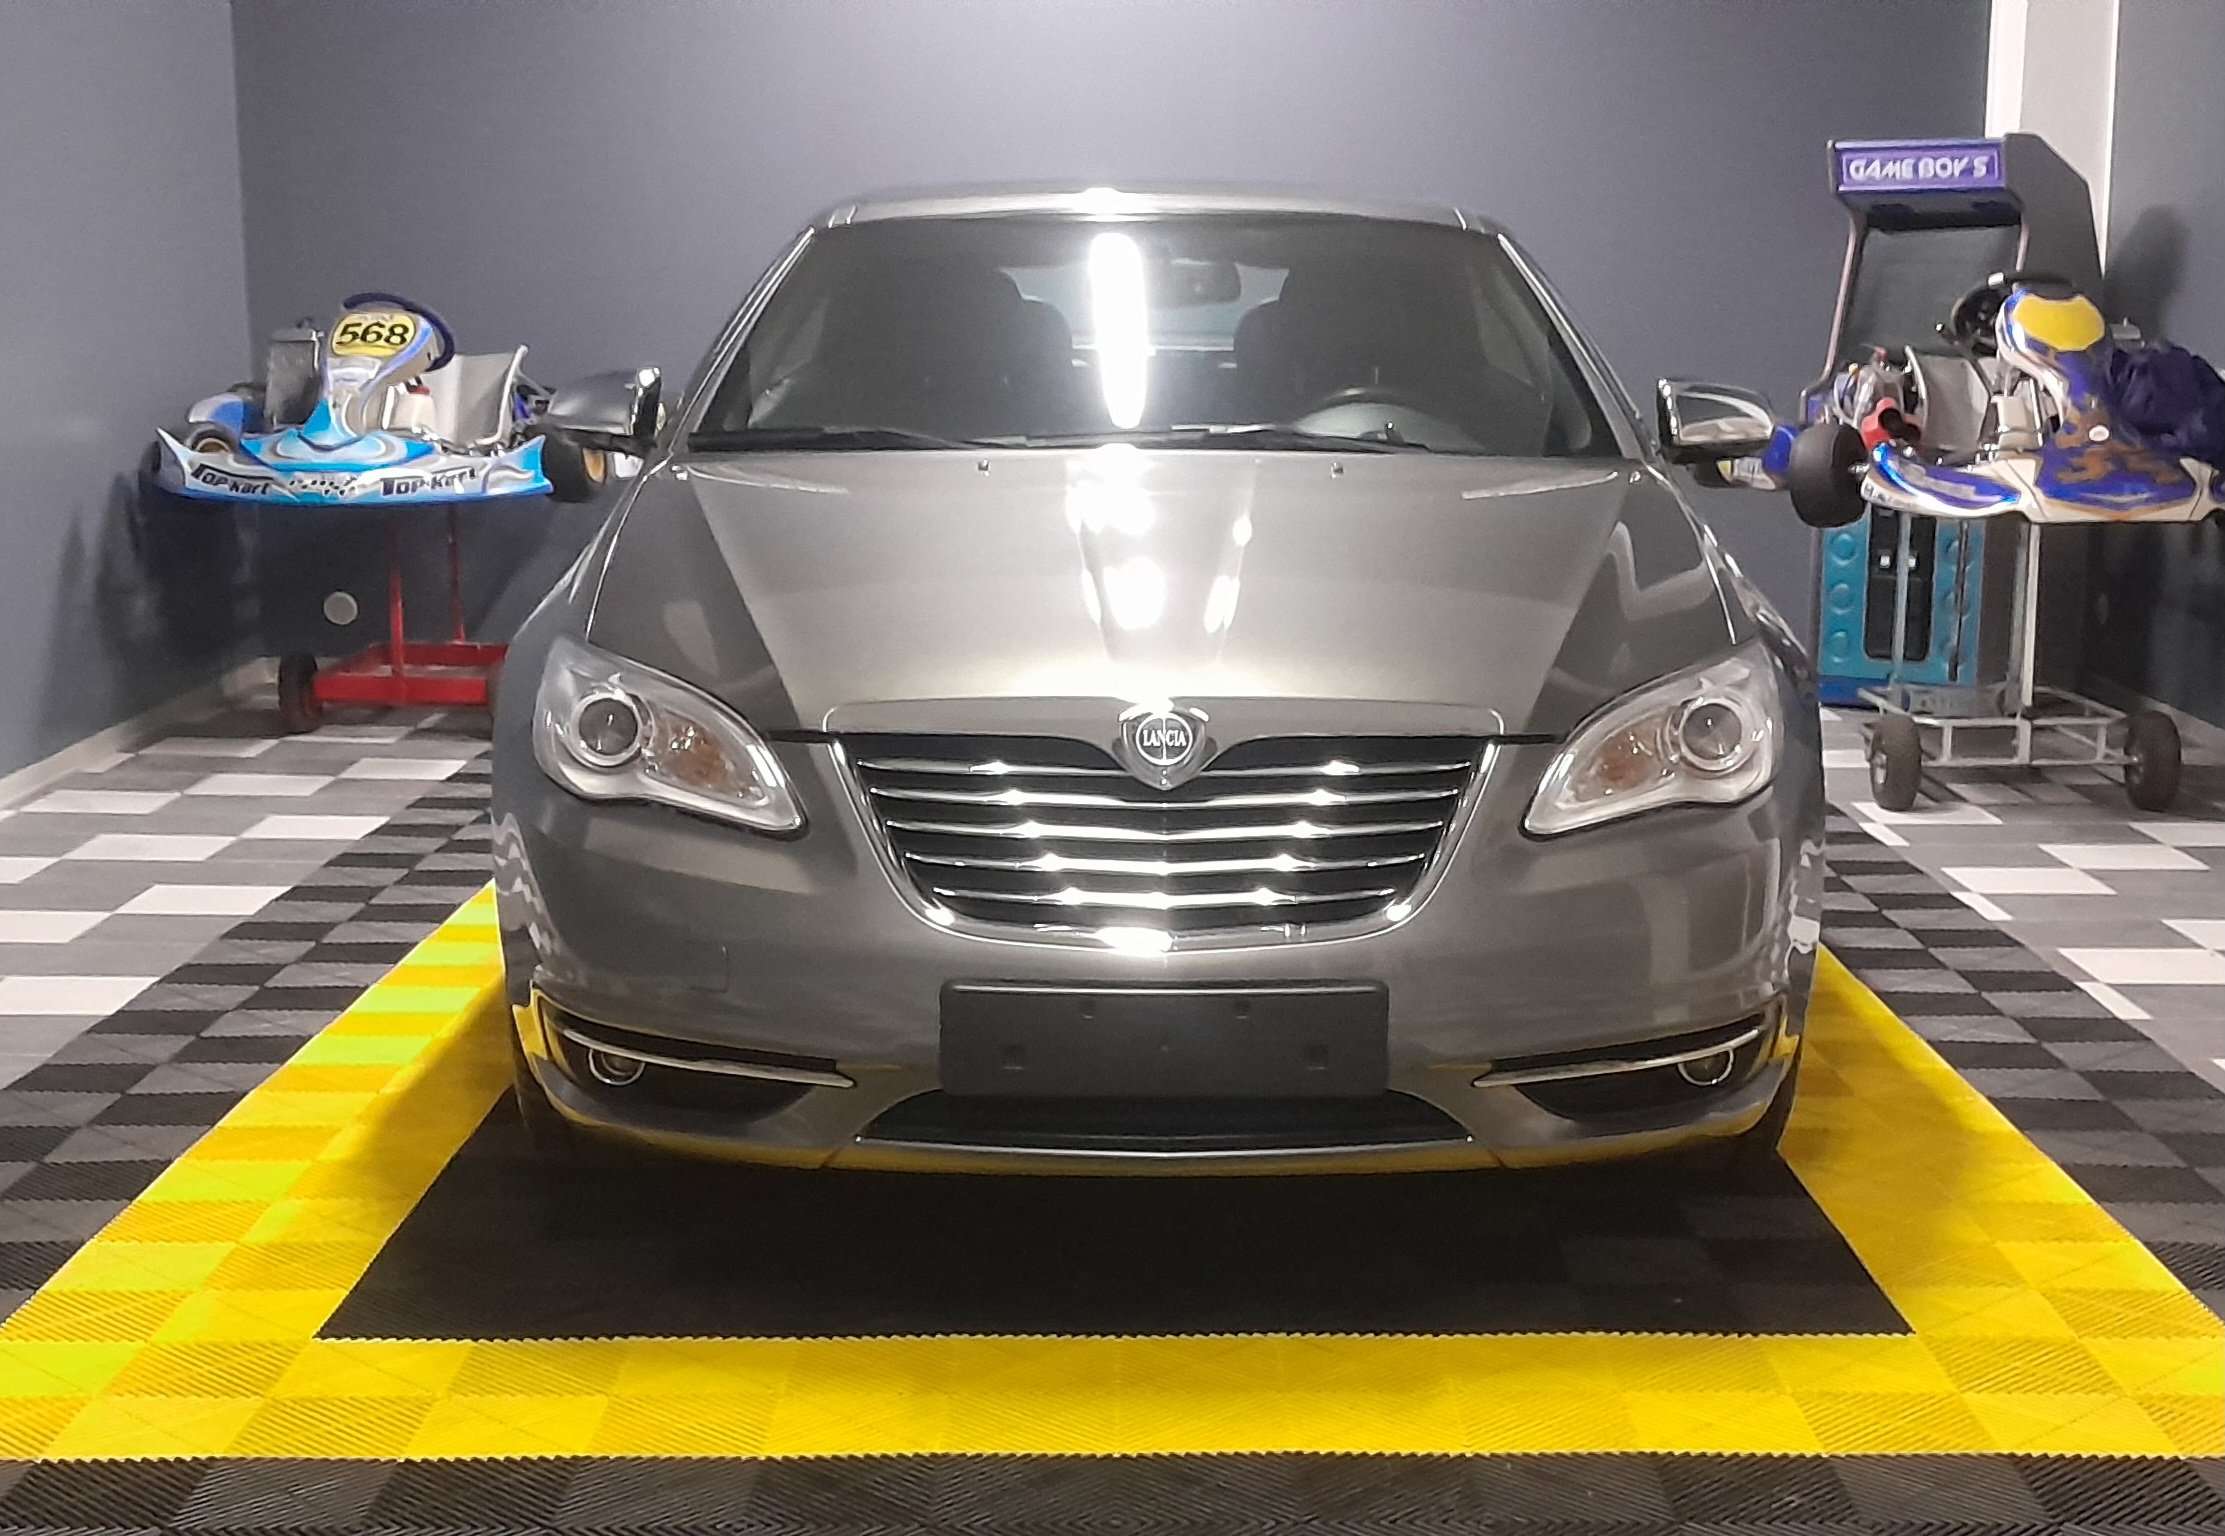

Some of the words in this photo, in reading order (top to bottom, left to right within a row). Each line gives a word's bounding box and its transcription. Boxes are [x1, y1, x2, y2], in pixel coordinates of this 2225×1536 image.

[1849, 157, 1915, 180] GAME
[336, 321, 409, 346] 568
[1142, 729, 1187, 747] LANCIA
